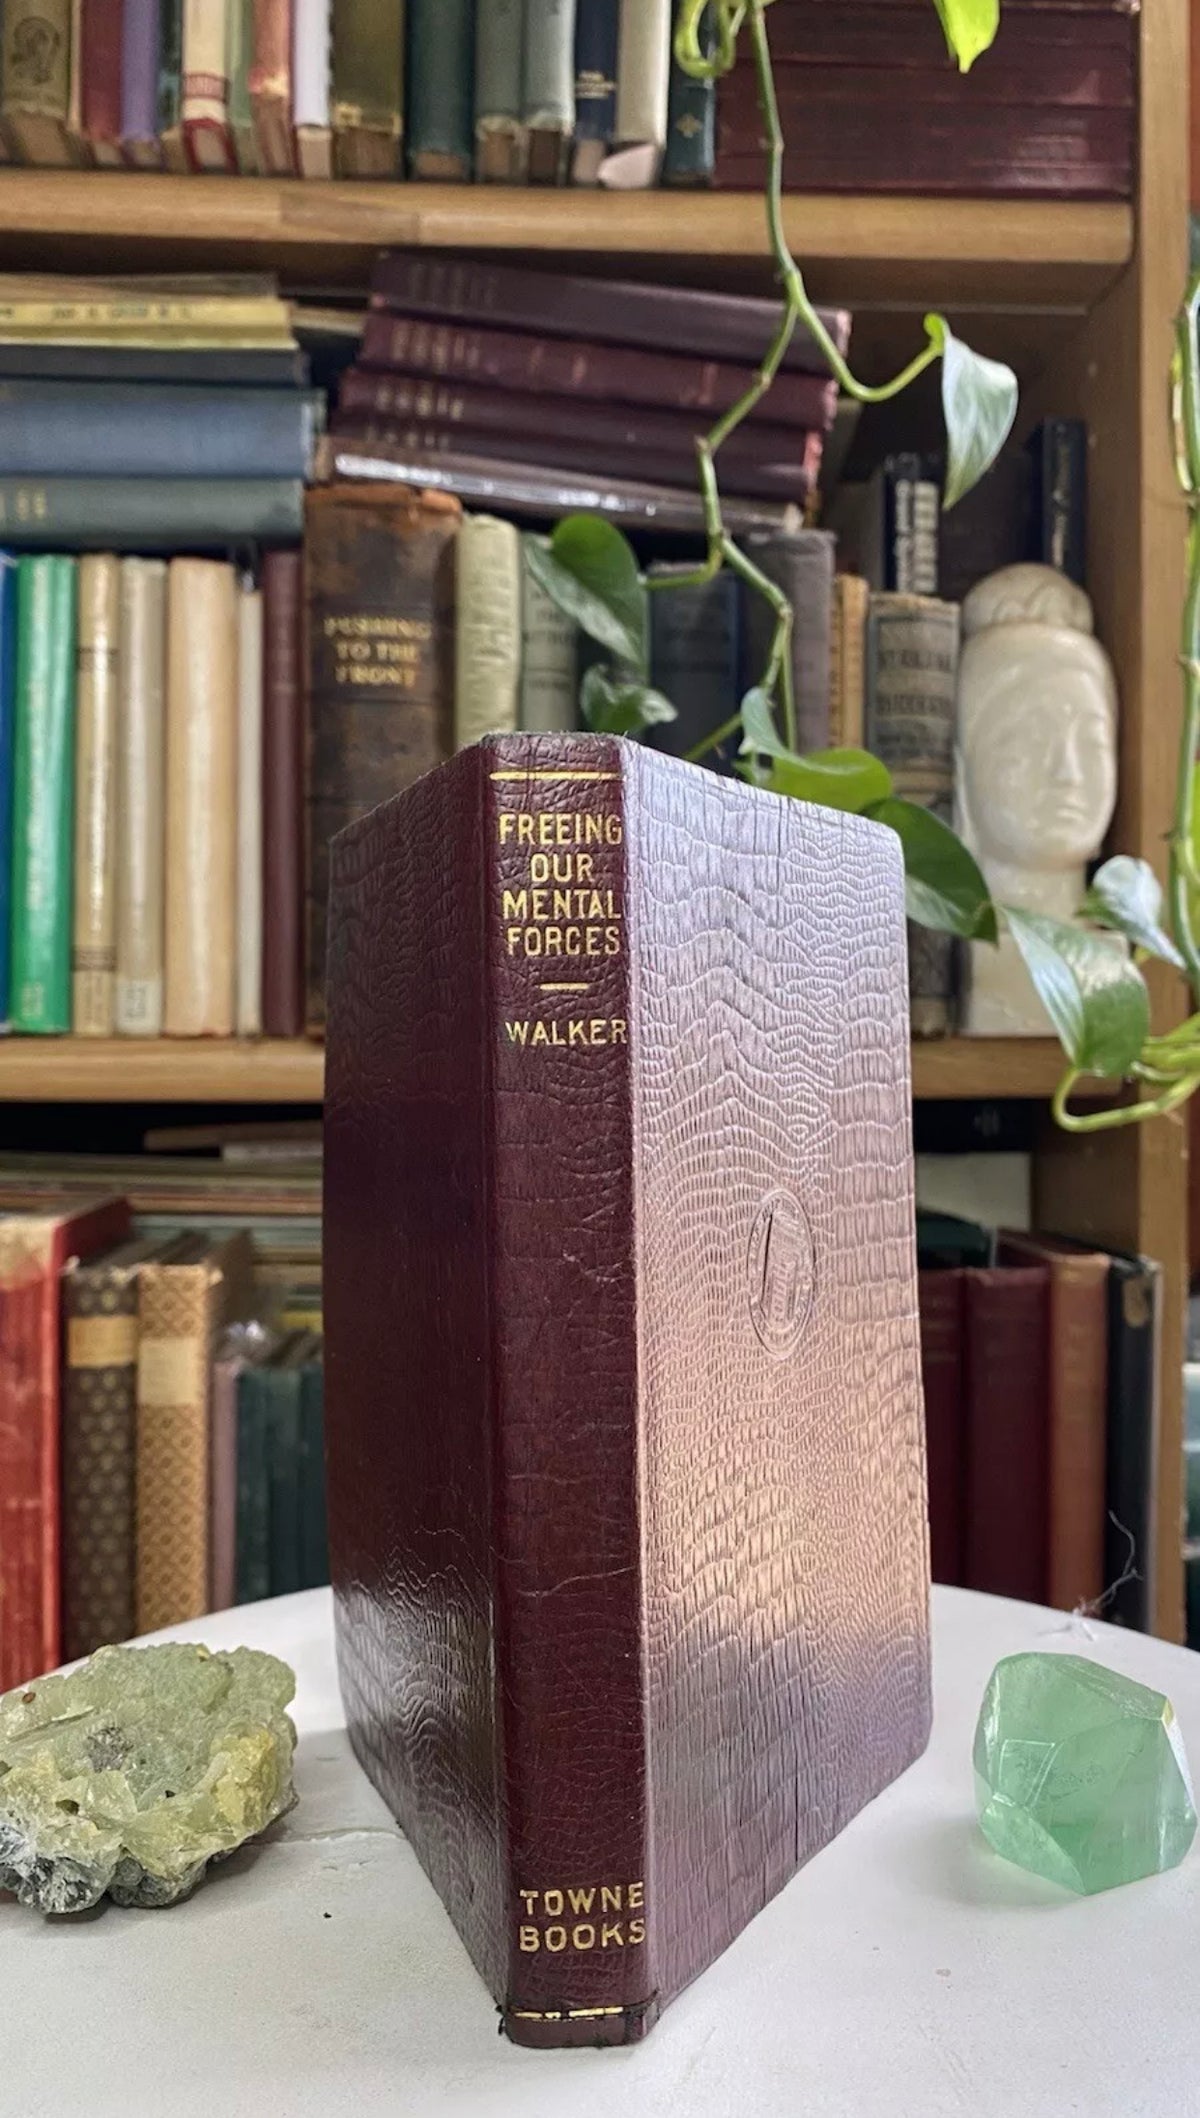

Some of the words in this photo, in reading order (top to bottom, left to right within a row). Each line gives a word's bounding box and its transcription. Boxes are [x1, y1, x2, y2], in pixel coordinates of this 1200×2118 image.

[336, 641, 371, 660] TO
[500, 813, 622, 845] FREEING
[531, 853, 594, 883] OUR
[503, 890, 621, 920] MENTAL
[508, 926, 620, 956] FORCES
[506, 1018, 627, 1046] WALKER
[519, 1881, 644, 1916] TOWNE
[519, 1918, 646, 1952] BOOKS
